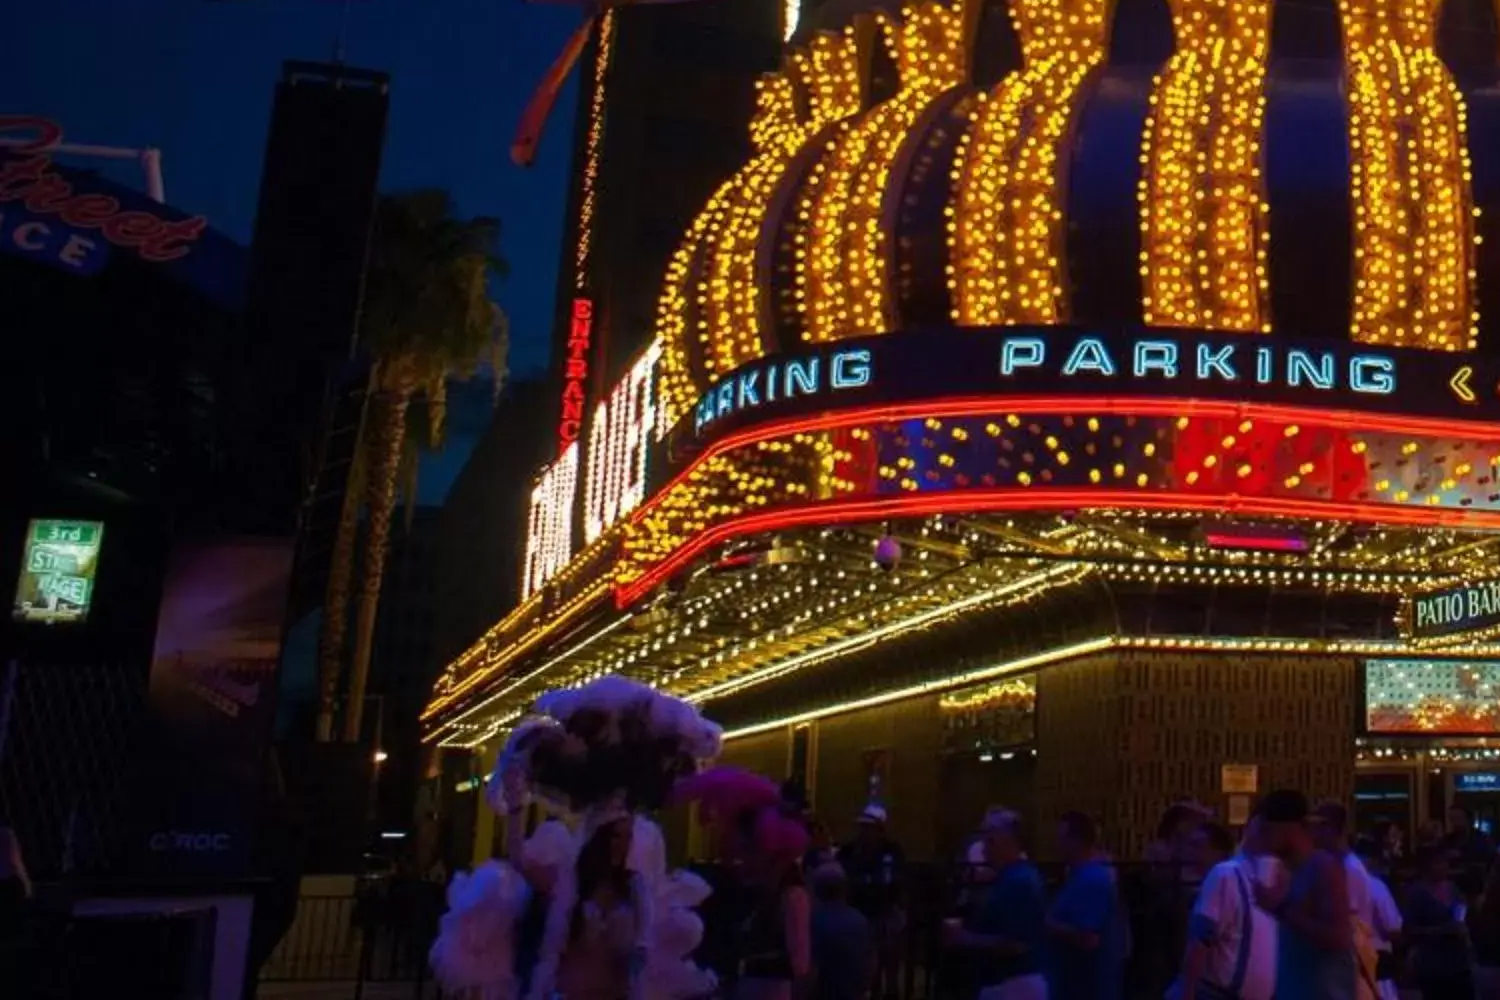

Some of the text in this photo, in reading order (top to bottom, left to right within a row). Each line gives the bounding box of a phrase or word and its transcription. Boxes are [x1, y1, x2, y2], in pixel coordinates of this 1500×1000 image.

[559, 298, 593, 452] ENTRANC
[1001, 338, 1396, 395] PARKING
[48, 526, 81, 541] 3rd
[1416, 593, 1463, 628] PATIO
